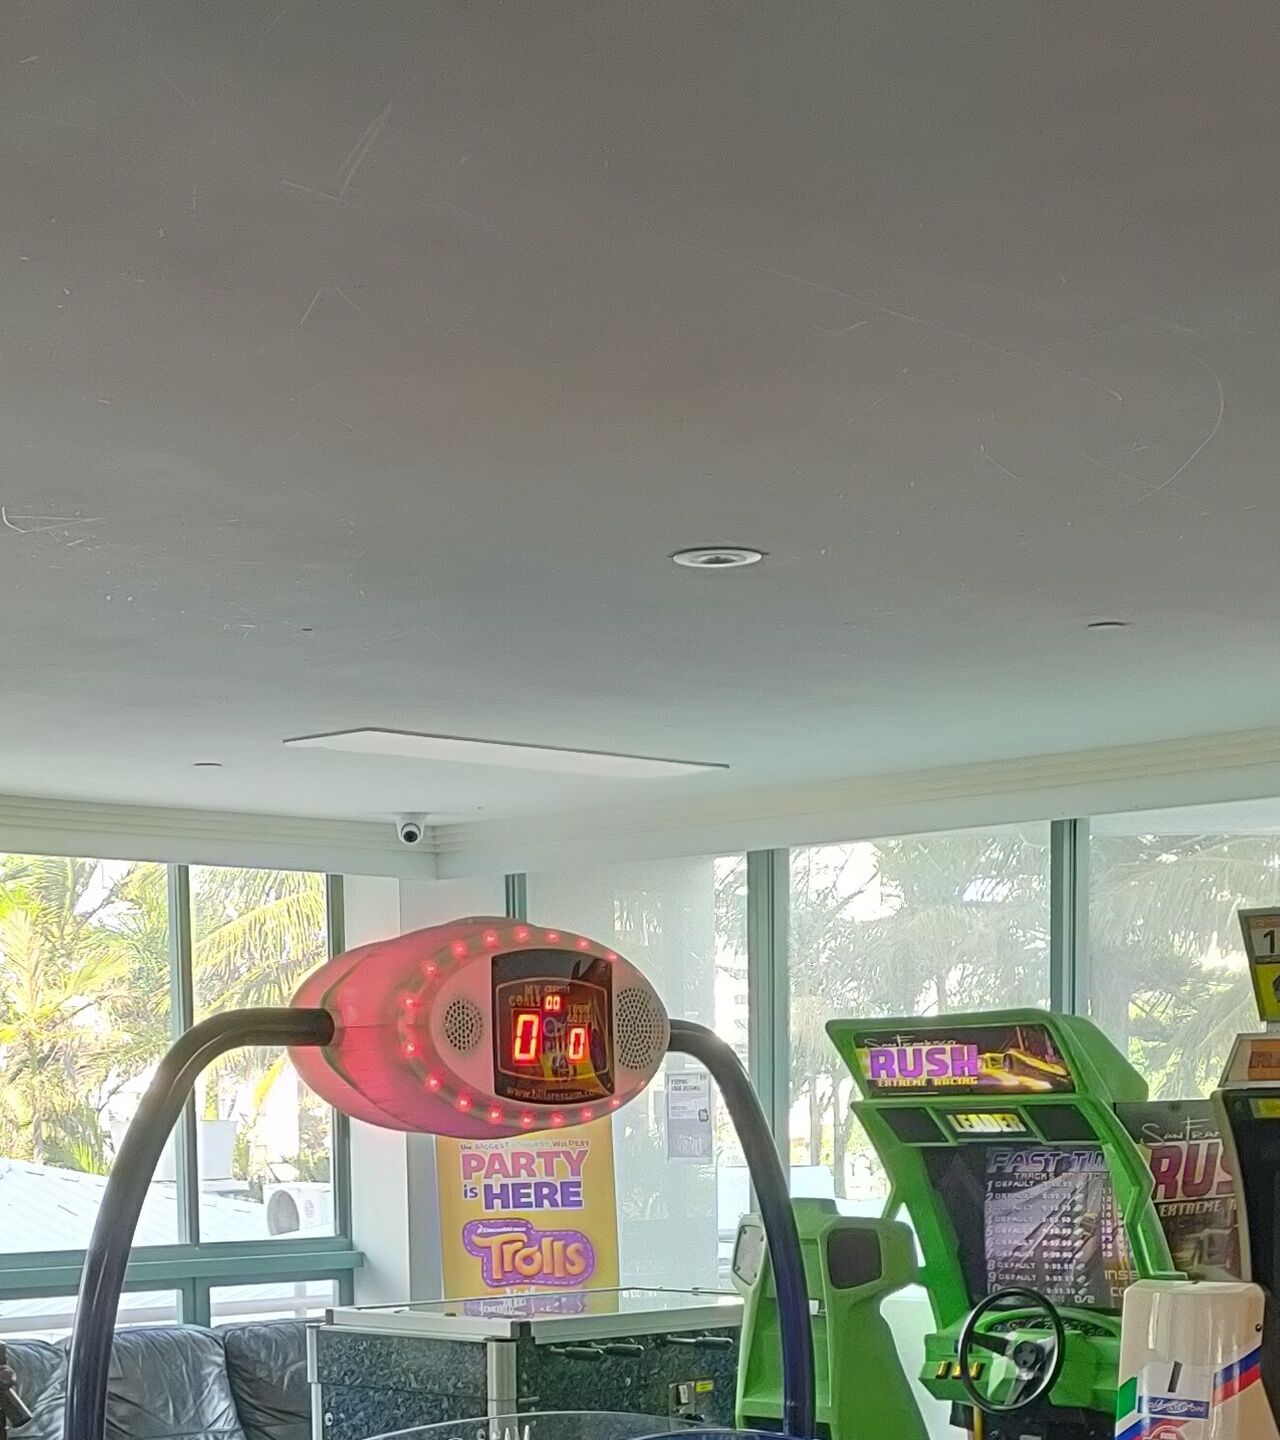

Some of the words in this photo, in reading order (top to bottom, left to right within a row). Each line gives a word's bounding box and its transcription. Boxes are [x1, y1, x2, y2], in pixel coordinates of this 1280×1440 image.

[1263, 929, 1276, 954] 1
[545, 995, 560, 1010] 00
[514, 1014, 539, 1061] 0
[568, 1027, 585, 1060] 0
[870, 1045, 978, 1079] RUSH
[878, 1078, 927, 1088] EXTREME
[932, 1076, 978, 1087] RACING
[947, 1113, 1027, 1133] LEADER
[461, 1150, 589, 1181] PARTY
[986, 1150, 1063, 1173] FAST
[463, 1184, 478, 1199] is
[483, 1180, 583, 1211] HERE
[1159, 1200, 1222, 1218] EXTREME
[471, 1232, 587, 1280] Trolls
[997, 1262, 1036, 1270] DEFAULT
[1104, 1270, 1137, 1281] INSE
